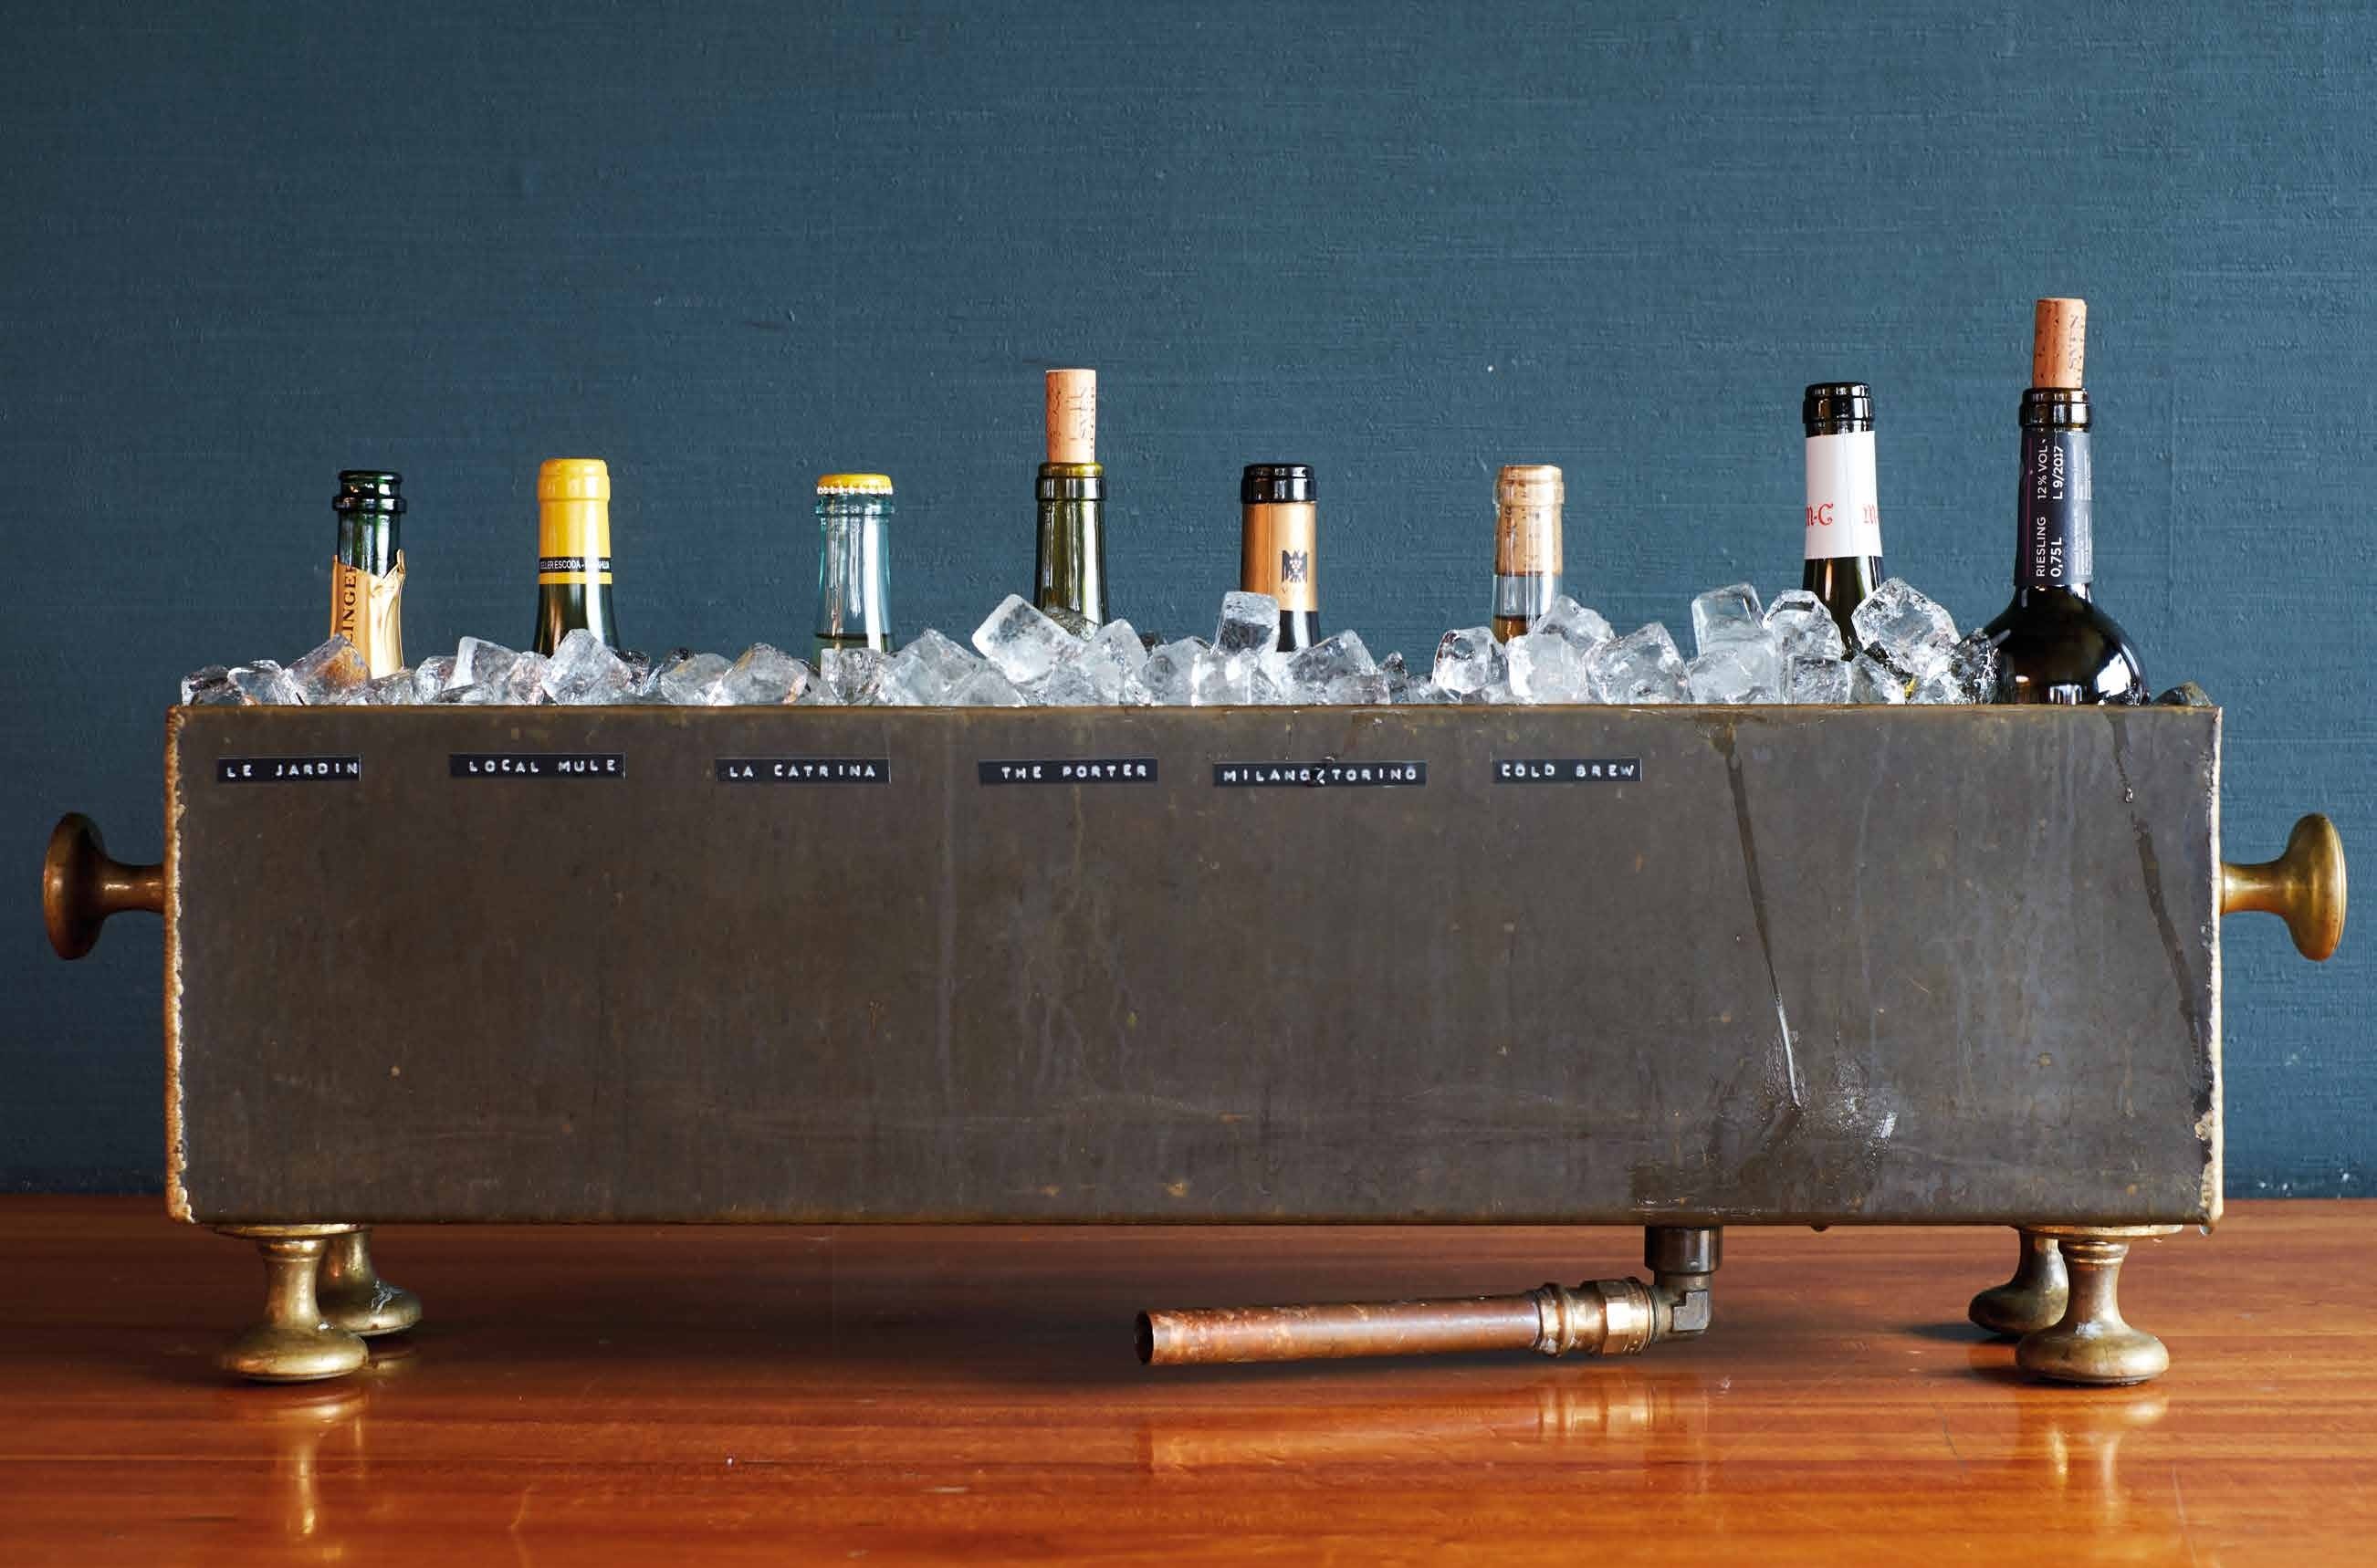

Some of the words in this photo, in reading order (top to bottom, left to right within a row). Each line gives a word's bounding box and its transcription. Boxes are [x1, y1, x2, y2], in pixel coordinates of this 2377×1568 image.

[2052, 445, 2065, 488] 9/2017
[2036, 517, 2047, 578] RIESLING
[341, 565, 357, 643] INGE
[226, 765, 252, 778] LE
[275, 762, 358, 777] JARDIN
[468, 759, 539, 773] LOCAL
[558, 759, 616, 772] MULE
[729, 765, 754, 778] LA
[774, 764, 876, 778] CATRINA
[1001, 766, 1042, 779] THE
[1063, 764, 1147, 778] PORTER
[1502, 763, 1555, 778] COLD
[1576, 764, 1635, 778] BREW
